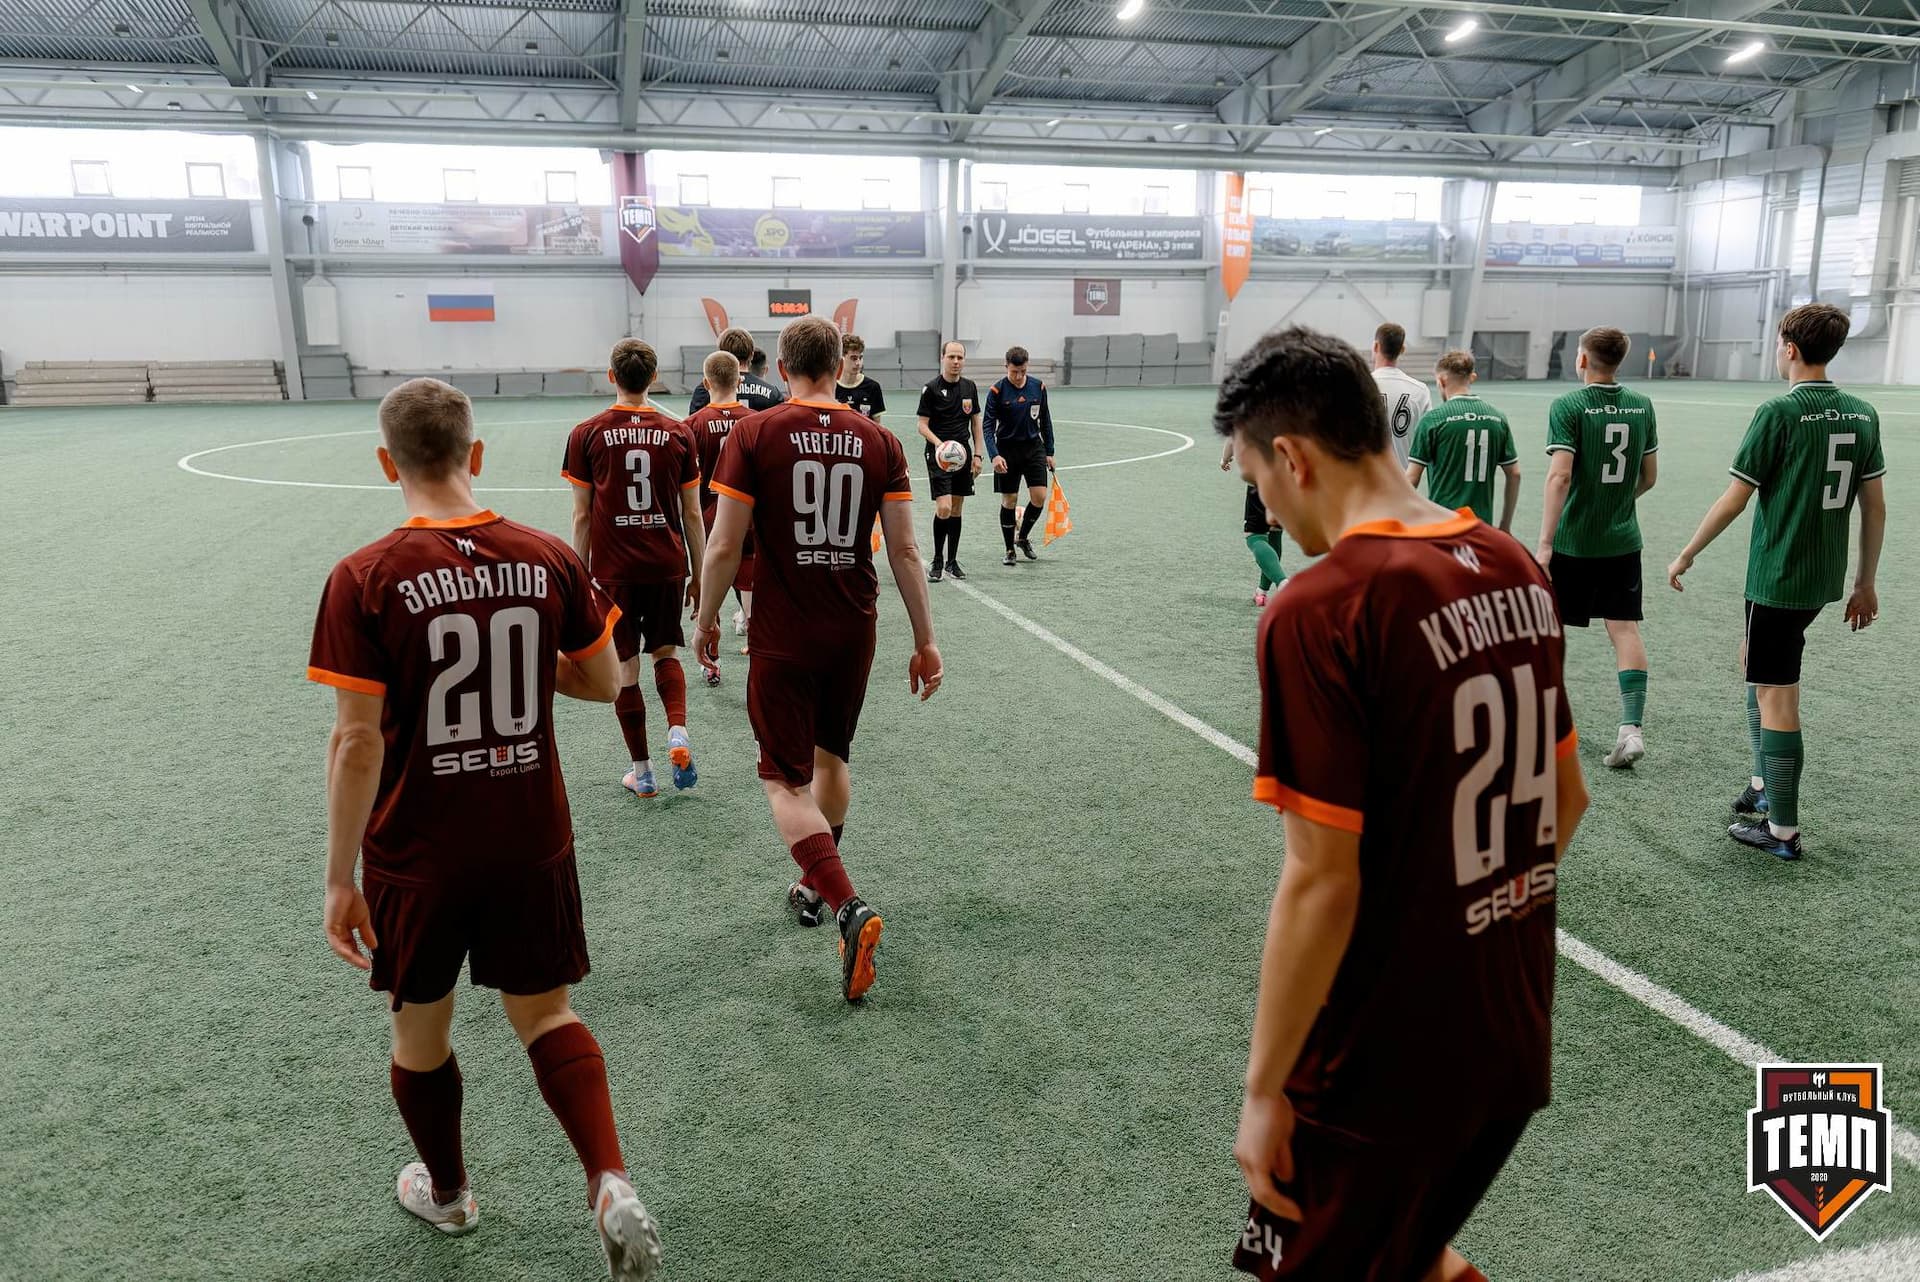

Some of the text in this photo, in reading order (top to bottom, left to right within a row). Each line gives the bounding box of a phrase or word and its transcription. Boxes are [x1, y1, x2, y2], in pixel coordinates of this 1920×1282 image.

[622, 208, 652, 226] ТЕМП
[1085, 227, 1201, 239] Футбольная экипировка
[1089, 240, 1111, 251] ТРЦ
[1163, 241, 1170, 250] 3
[603, 428, 670, 447] ВЕРНИГОР
[789, 430, 863, 459] ЧЕВЕЛЁВ
[1464, 429, 1489, 483] 11
[1601, 423, 1630, 484] 3
[625, 449, 652, 511] 3
[1822, 433, 1856, 510] 5
[615, 514, 667, 526] SEUS
[792, 460, 864, 548] 90
[397, 562, 548, 615] ЗАВЬЯЛОВ
[1419, 583, 1561, 671] КУЗНЕЦОВ
[427, 606, 540, 746] 20
[432, 741, 539, 776] SEUS
[490, 767, 518, 777] Export
[1453, 663, 1558, 887] 24
[1466, 862, 1556, 936] SEUS
[1242, 1217, 1283, 1272] 24
